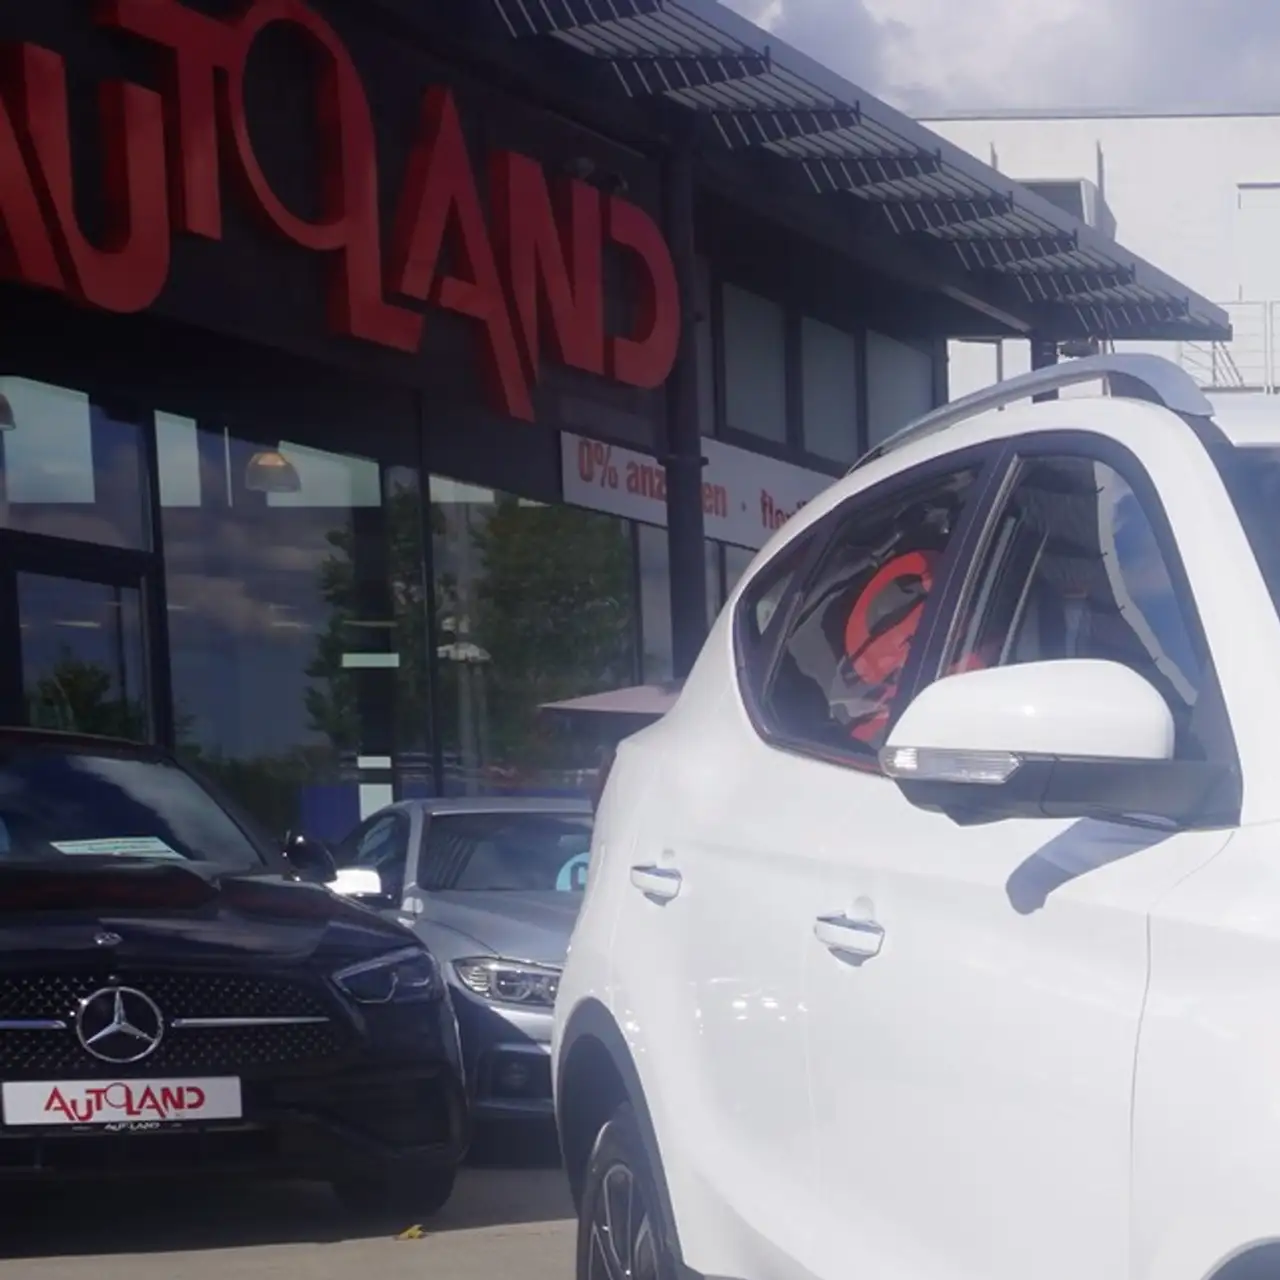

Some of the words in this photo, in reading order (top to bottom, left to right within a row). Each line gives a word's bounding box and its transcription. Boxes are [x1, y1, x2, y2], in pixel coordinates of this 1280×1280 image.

[577, 439, 618, 489] 0%
[626, 460, 728, 518] anzen
[44, 1082, 205, 1121] AUTOLAND
